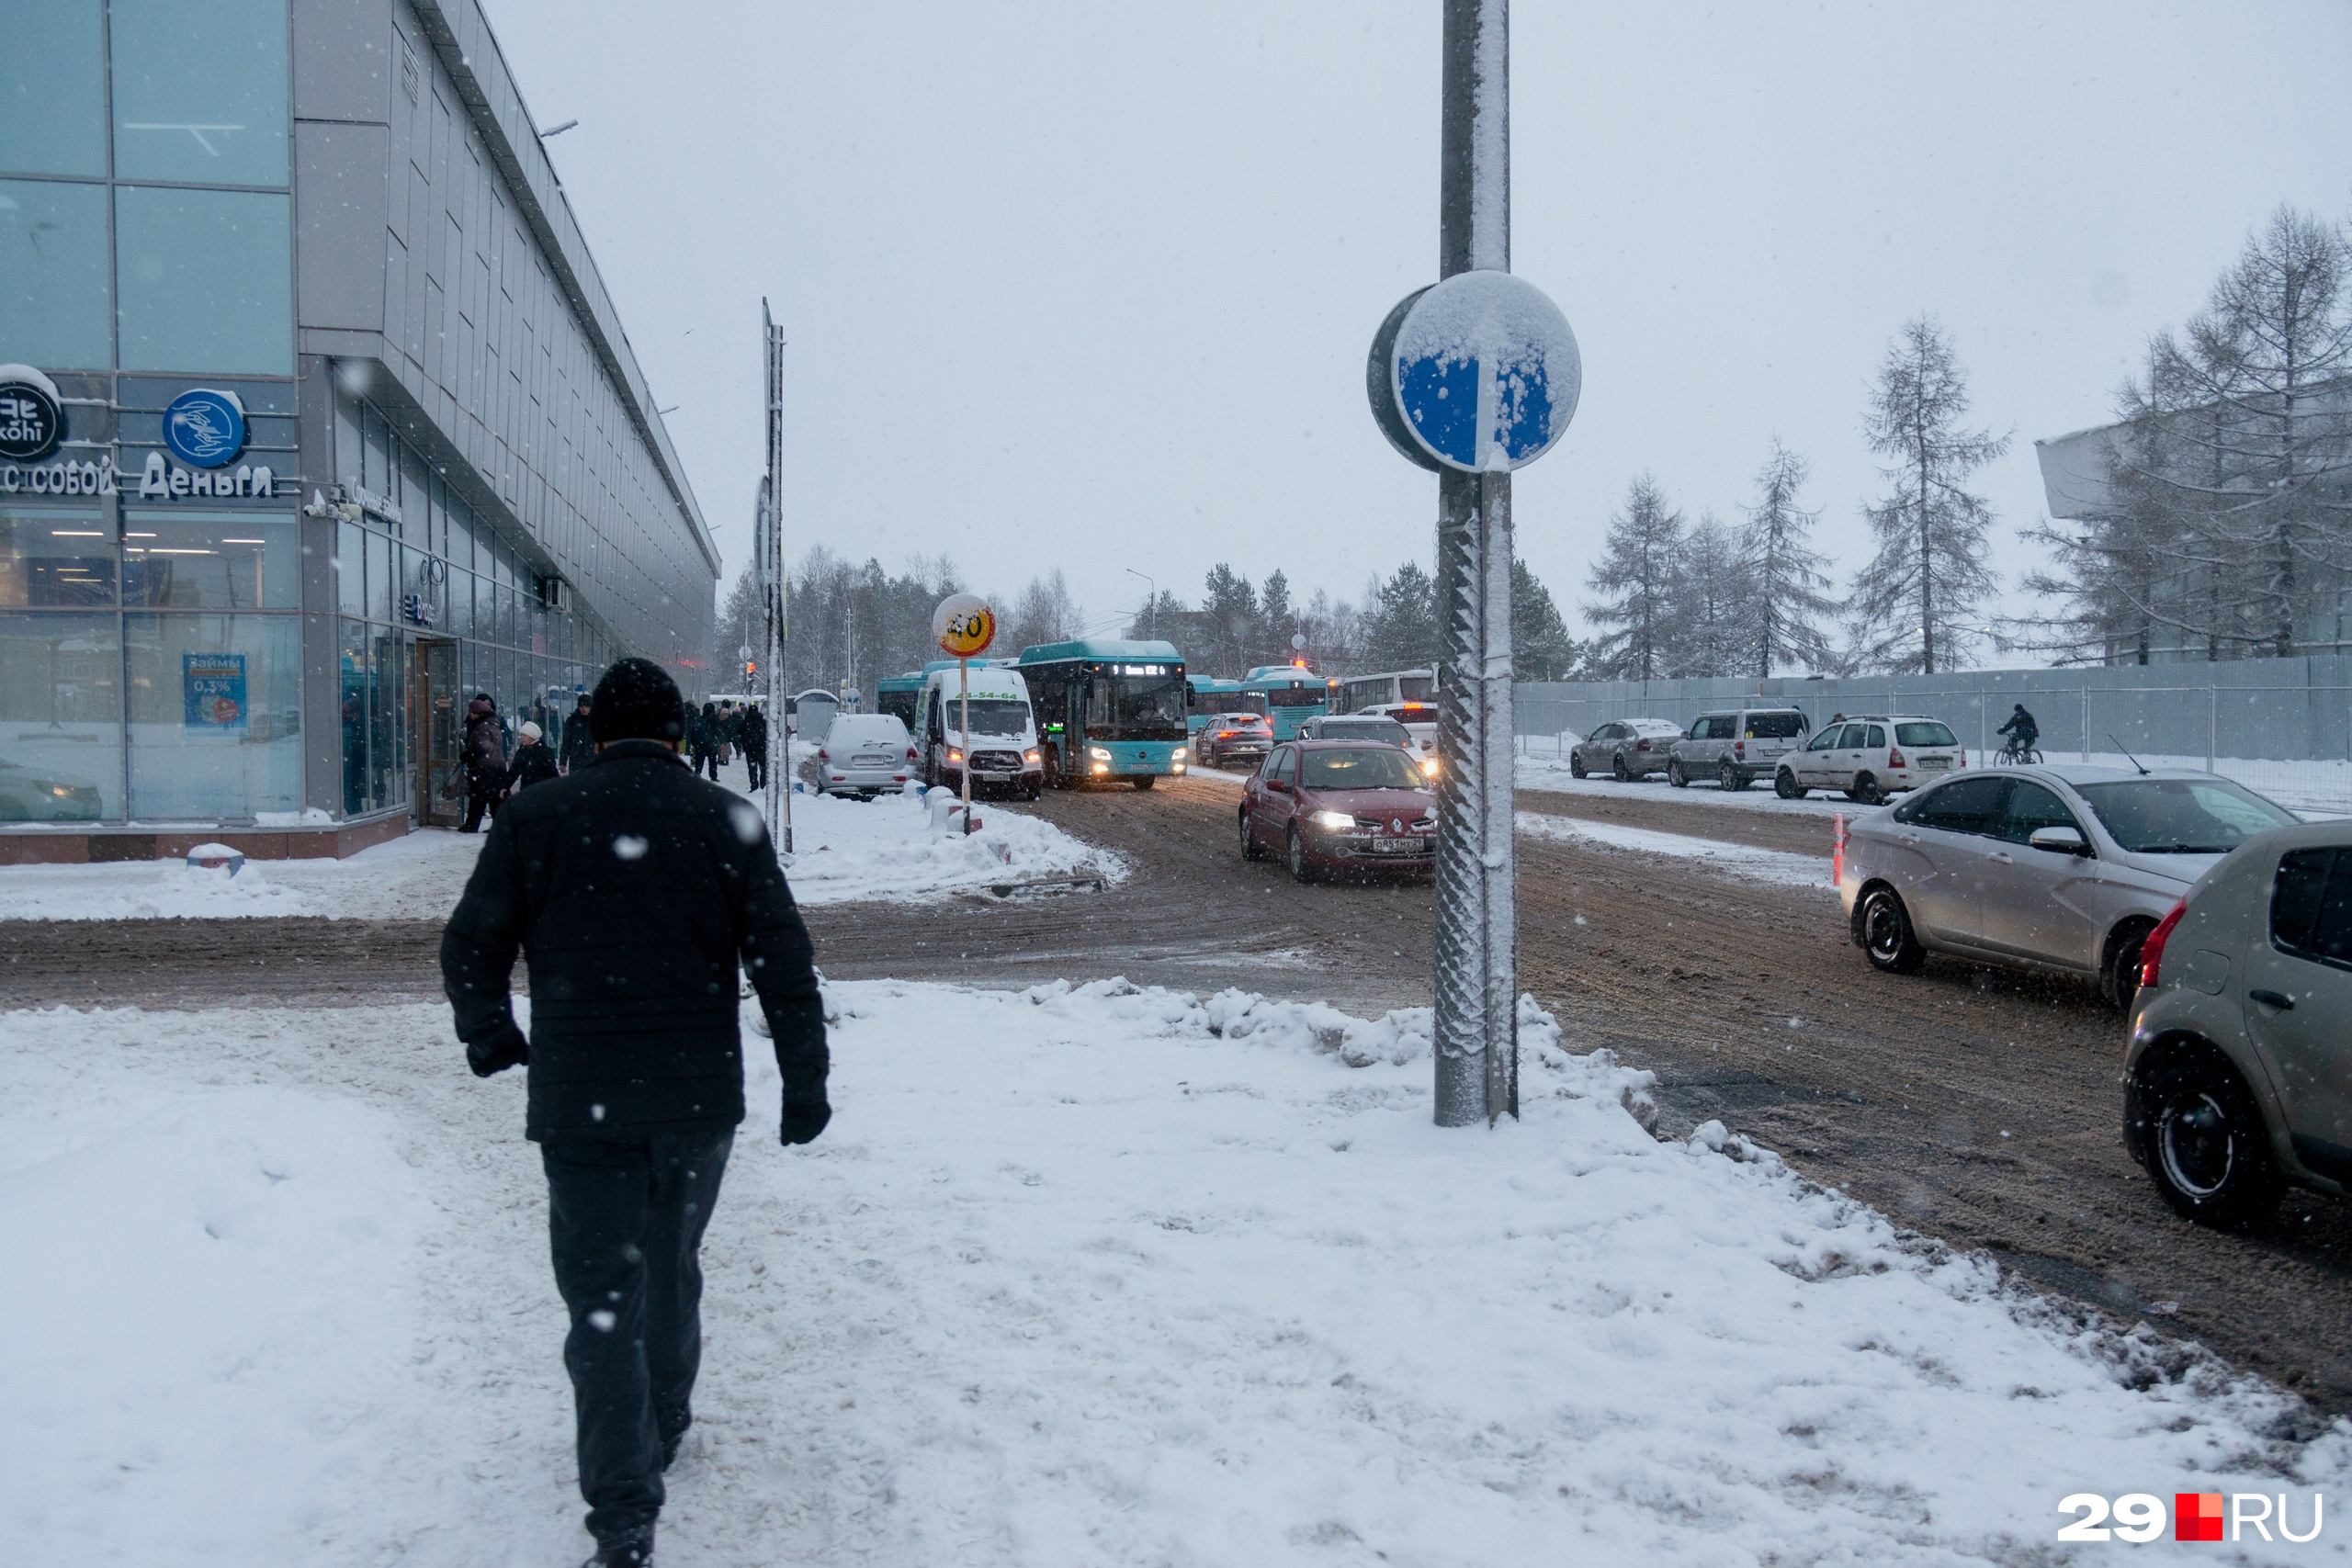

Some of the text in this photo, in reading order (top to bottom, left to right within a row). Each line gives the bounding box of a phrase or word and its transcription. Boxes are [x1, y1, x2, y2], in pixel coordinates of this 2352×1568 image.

[140, 455, 273, 499] Деньги
[189, 657, 241, 669] Займы
[194, 680, 231, 693] 0,3%
